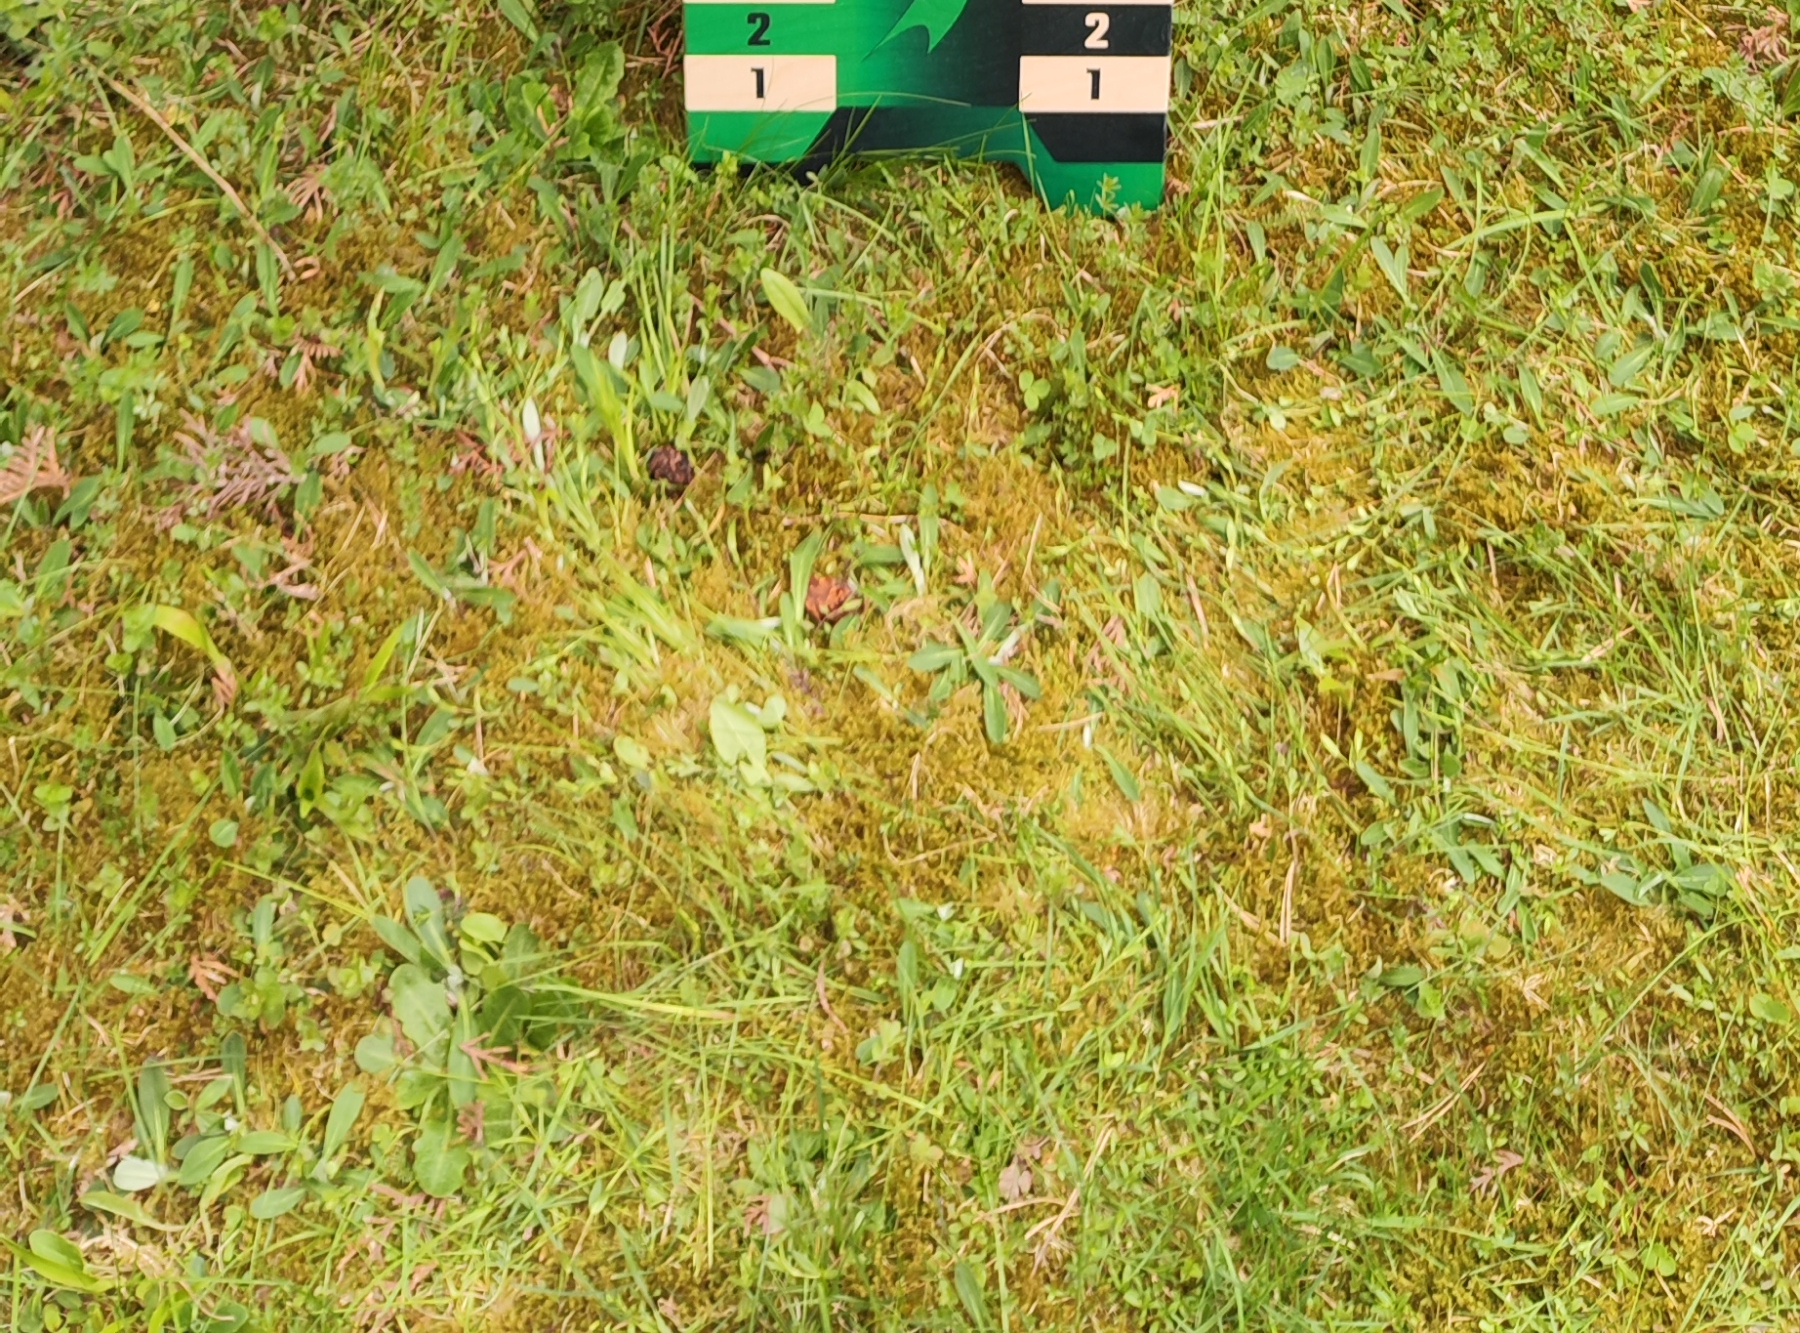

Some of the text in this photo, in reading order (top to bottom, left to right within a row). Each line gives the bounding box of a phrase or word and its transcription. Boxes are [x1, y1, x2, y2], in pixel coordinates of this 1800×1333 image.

[747, 12, 771, 46] 2
[1084, 11, 1110, 49] 2
[750, 67, 765, 99] 1
[1086, 68, 1101, 100] 1
